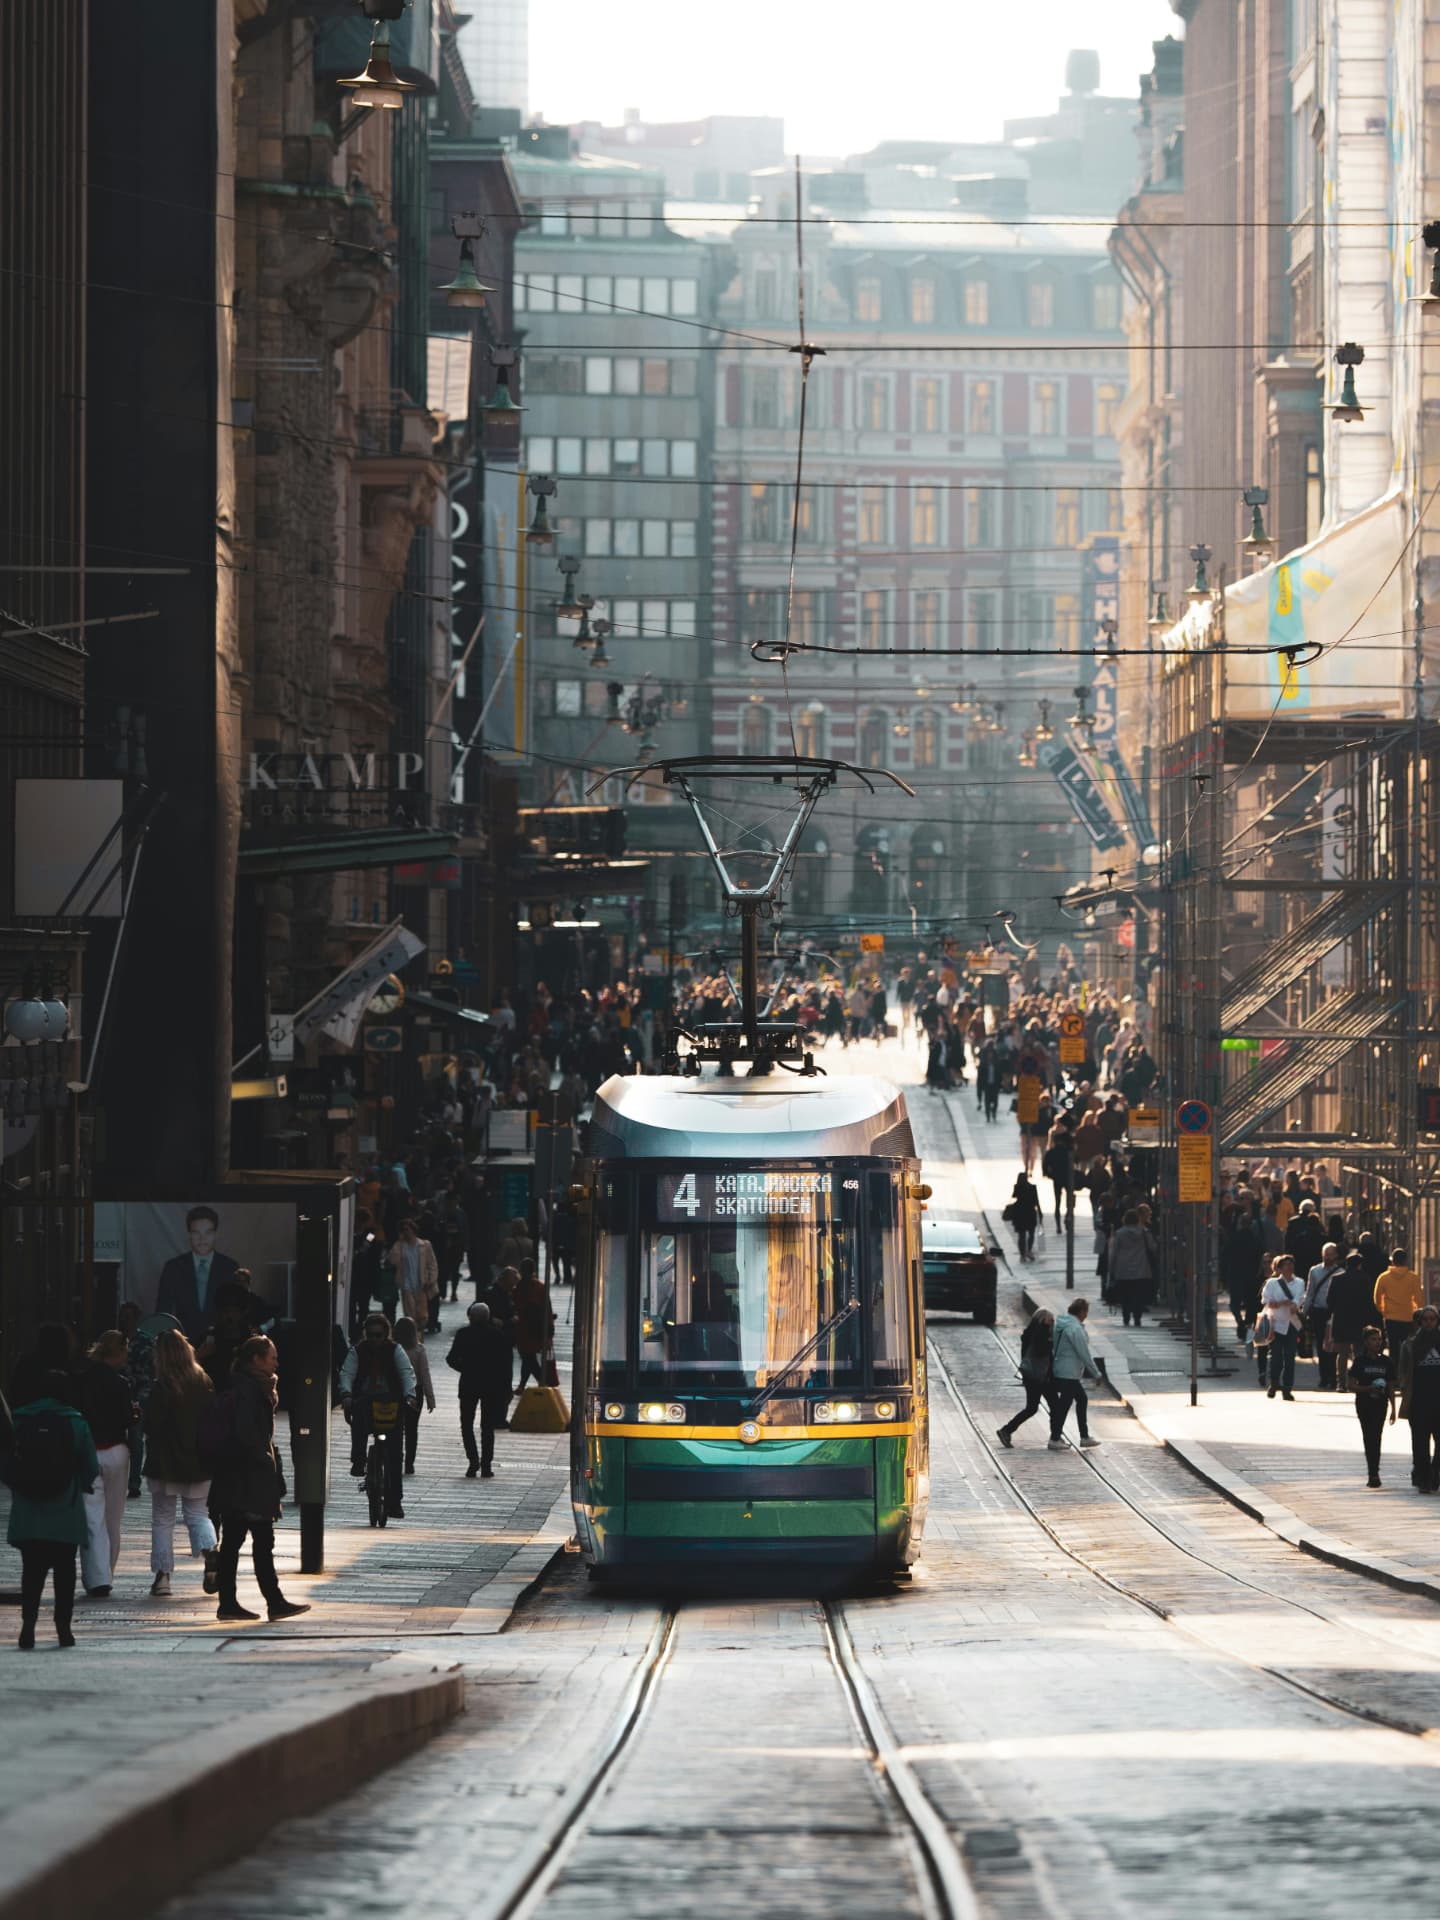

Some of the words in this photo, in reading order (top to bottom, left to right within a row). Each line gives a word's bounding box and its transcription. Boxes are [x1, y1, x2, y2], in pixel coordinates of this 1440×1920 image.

[715, 1175, 833, 1193] KATAJANOKKA
[842, 1179, 859, 1190] 456
[672, 1173, 701, 1217] 4
[715, 1196, 812, 1215] SKATUDDEN
